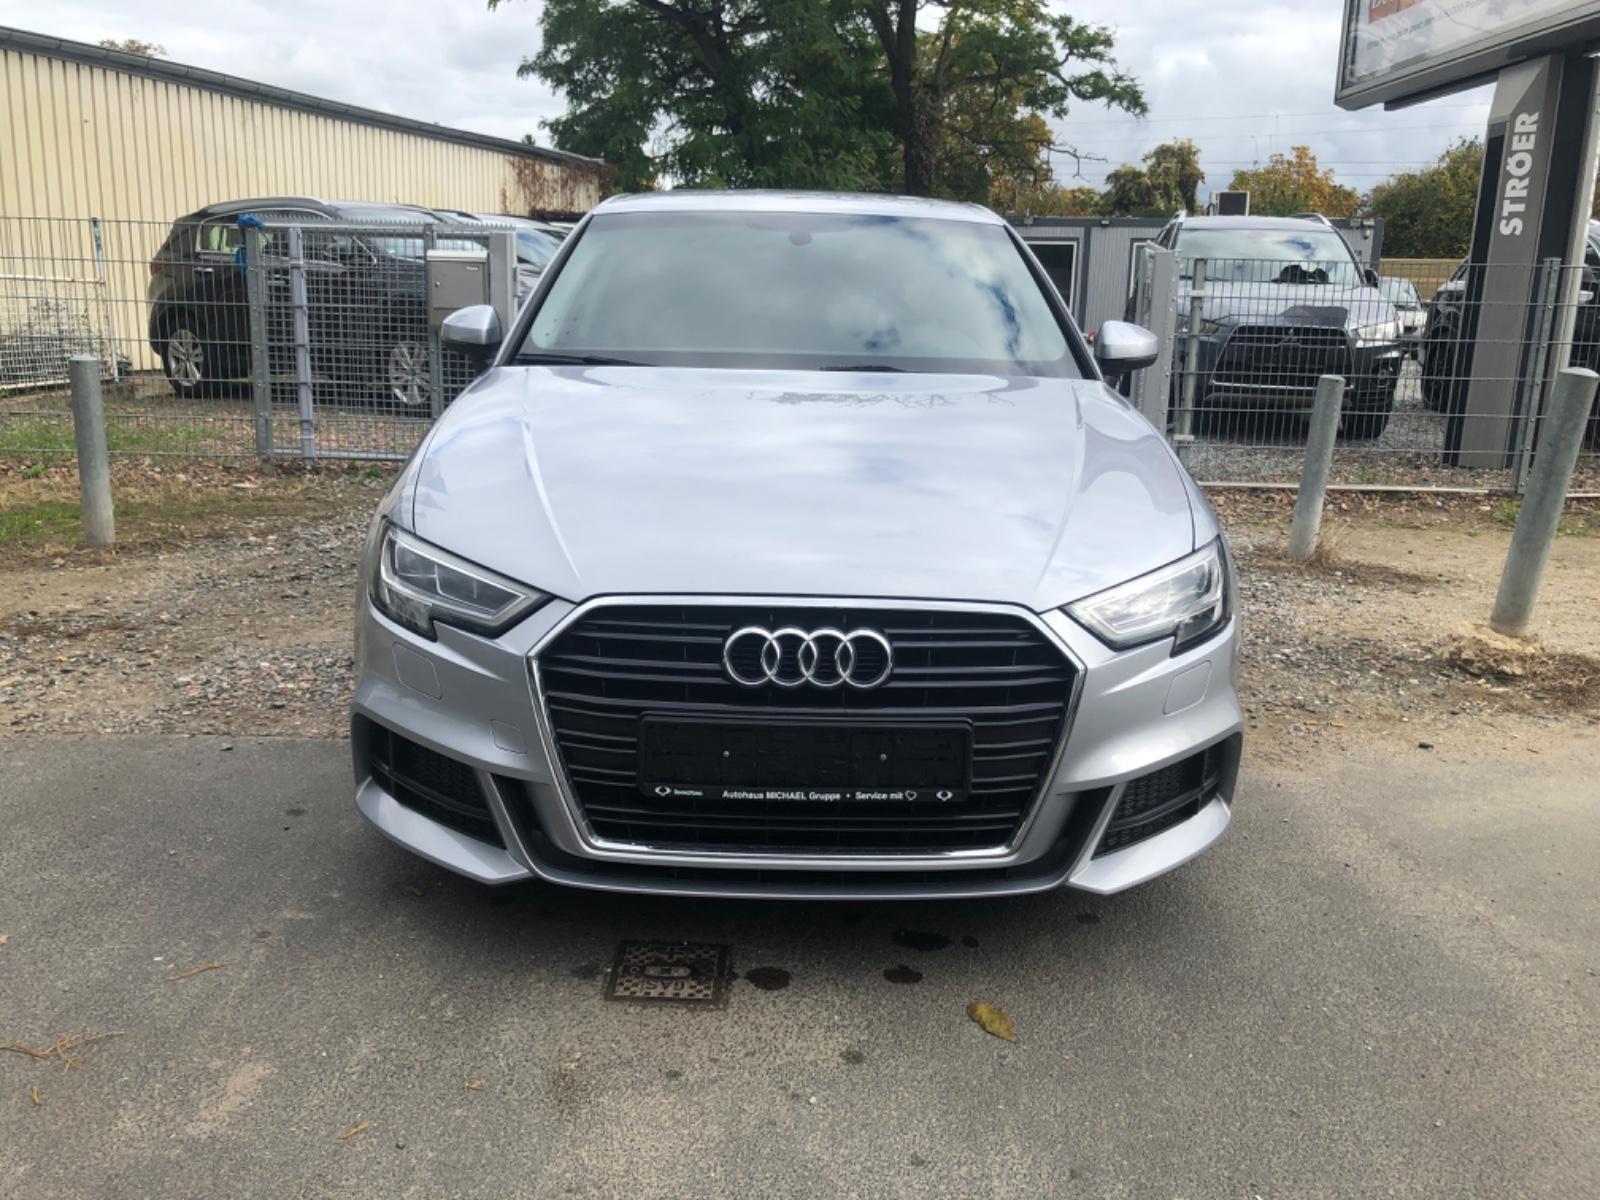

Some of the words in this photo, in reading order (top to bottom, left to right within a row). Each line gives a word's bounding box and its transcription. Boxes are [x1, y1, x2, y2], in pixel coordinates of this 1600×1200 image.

[1499, 112, 1539, 236] STRÖER
[722, 790, 764, 800] Autohaus
[766, 791, 807, 800] MICHAEL
[809, 791, 841, 802] Gruppe
[855, 791, 888, 800] Service
[889, 791, 904, 800] mit
